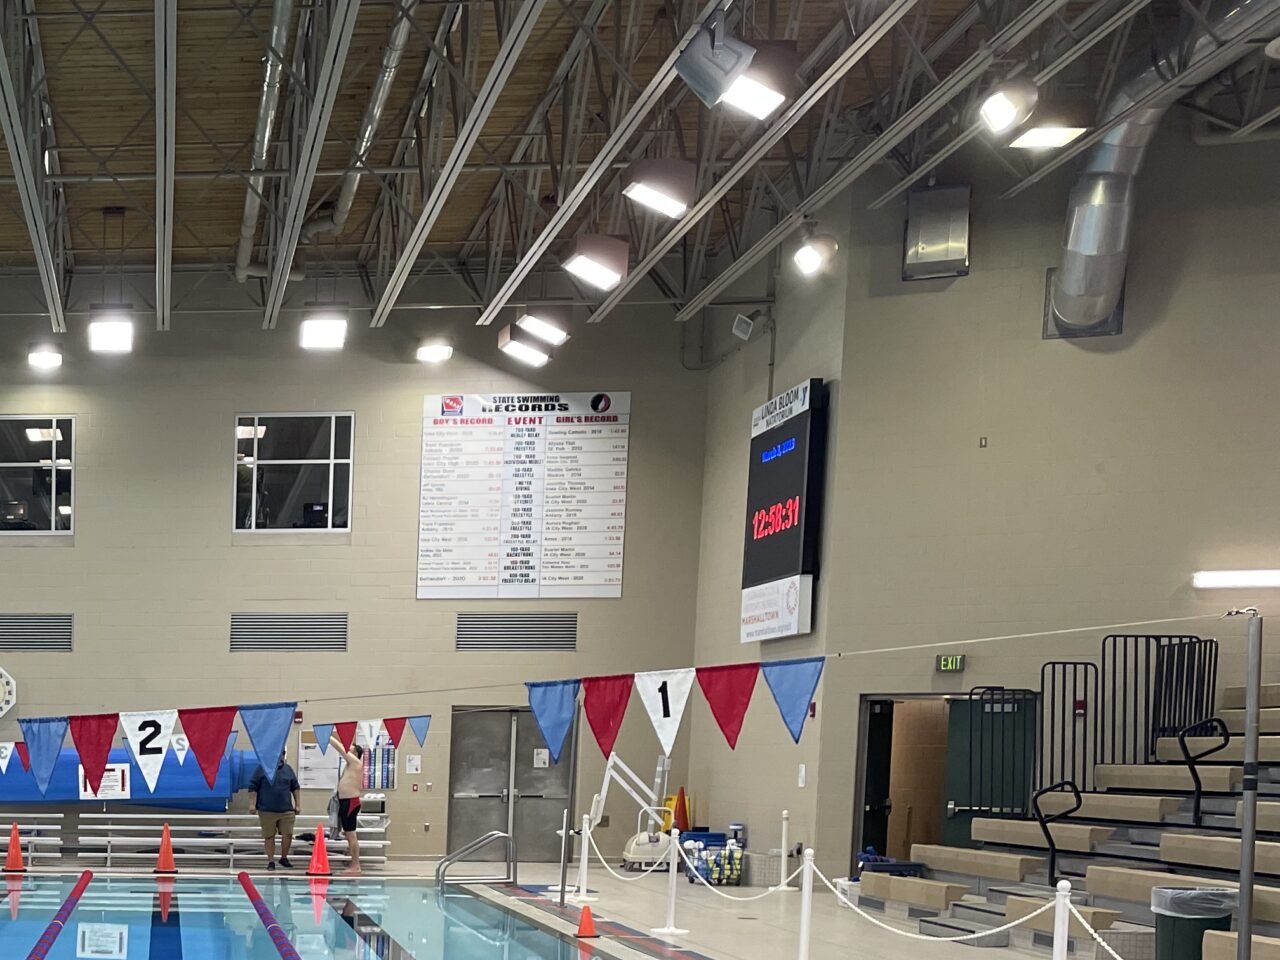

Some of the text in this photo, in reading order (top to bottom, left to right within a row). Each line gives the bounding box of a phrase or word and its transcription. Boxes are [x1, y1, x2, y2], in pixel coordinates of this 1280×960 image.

[492, 395, 560, 404] STATE SWIMMING
[762, 400, 778, 420] LINDA
[778, 386, 800, 410] BLOOM
[460, 417, 494, 425] RECORD
[507, 416, 544, 425] EVENT
[556, 415, 619, 424] GIRL'S RECORD
[753, 496, 799, 540] 12:58:31
[941, 655, 962, 670] EXIT
[658, 681, 671, 718] 1
[138, 719, 163, 756] 2
